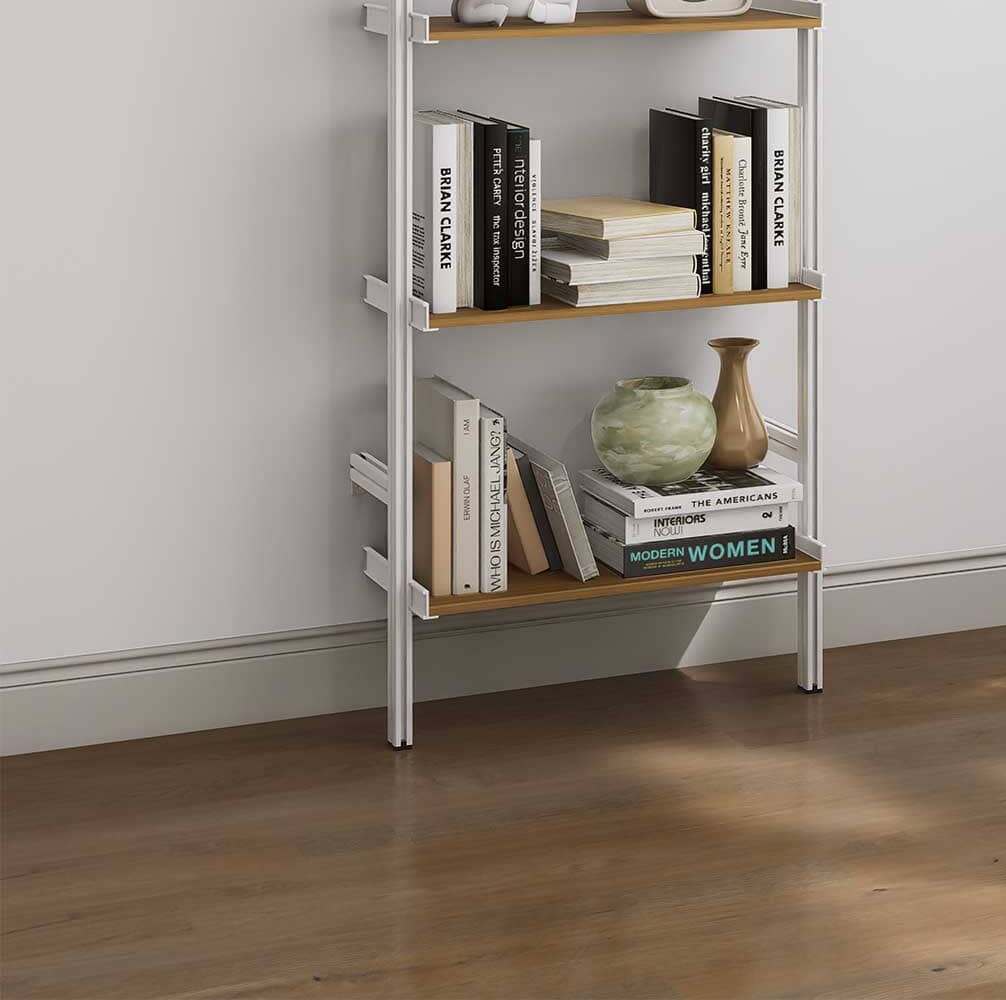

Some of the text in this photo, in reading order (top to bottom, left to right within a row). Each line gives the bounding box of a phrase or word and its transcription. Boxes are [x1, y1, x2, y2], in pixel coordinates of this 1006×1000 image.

[699, 127, 711, 185] charity girl
[493, 147, 503, 206] PETER CAREY
[738, 159, 748, 197] Charlotte
[773, 150, 784, 247] BRIAN CLARKE
[440, 168, 451, 270] BRIAN CLARKE
[492, 215, 501, 230] the
[701, 192, 711, 232] michael
[738, 230, 749, 249] Jane
[491, 247, 502, 287] inspector
[738, 251, 749, 269] Eyre
[463, 418, 470, 431] AM
[489, 430, 502, 592] WHO IS MICHAEL JANG?
[691, 491, 779, 508] THE AMERICANS
[653, 513, 707, 528] INTERIORS
[761, 511, 773, 519] 2
[653, 526, 684, 537] NOW!
[629, 537, 776, 562] MODERN WOMEN
